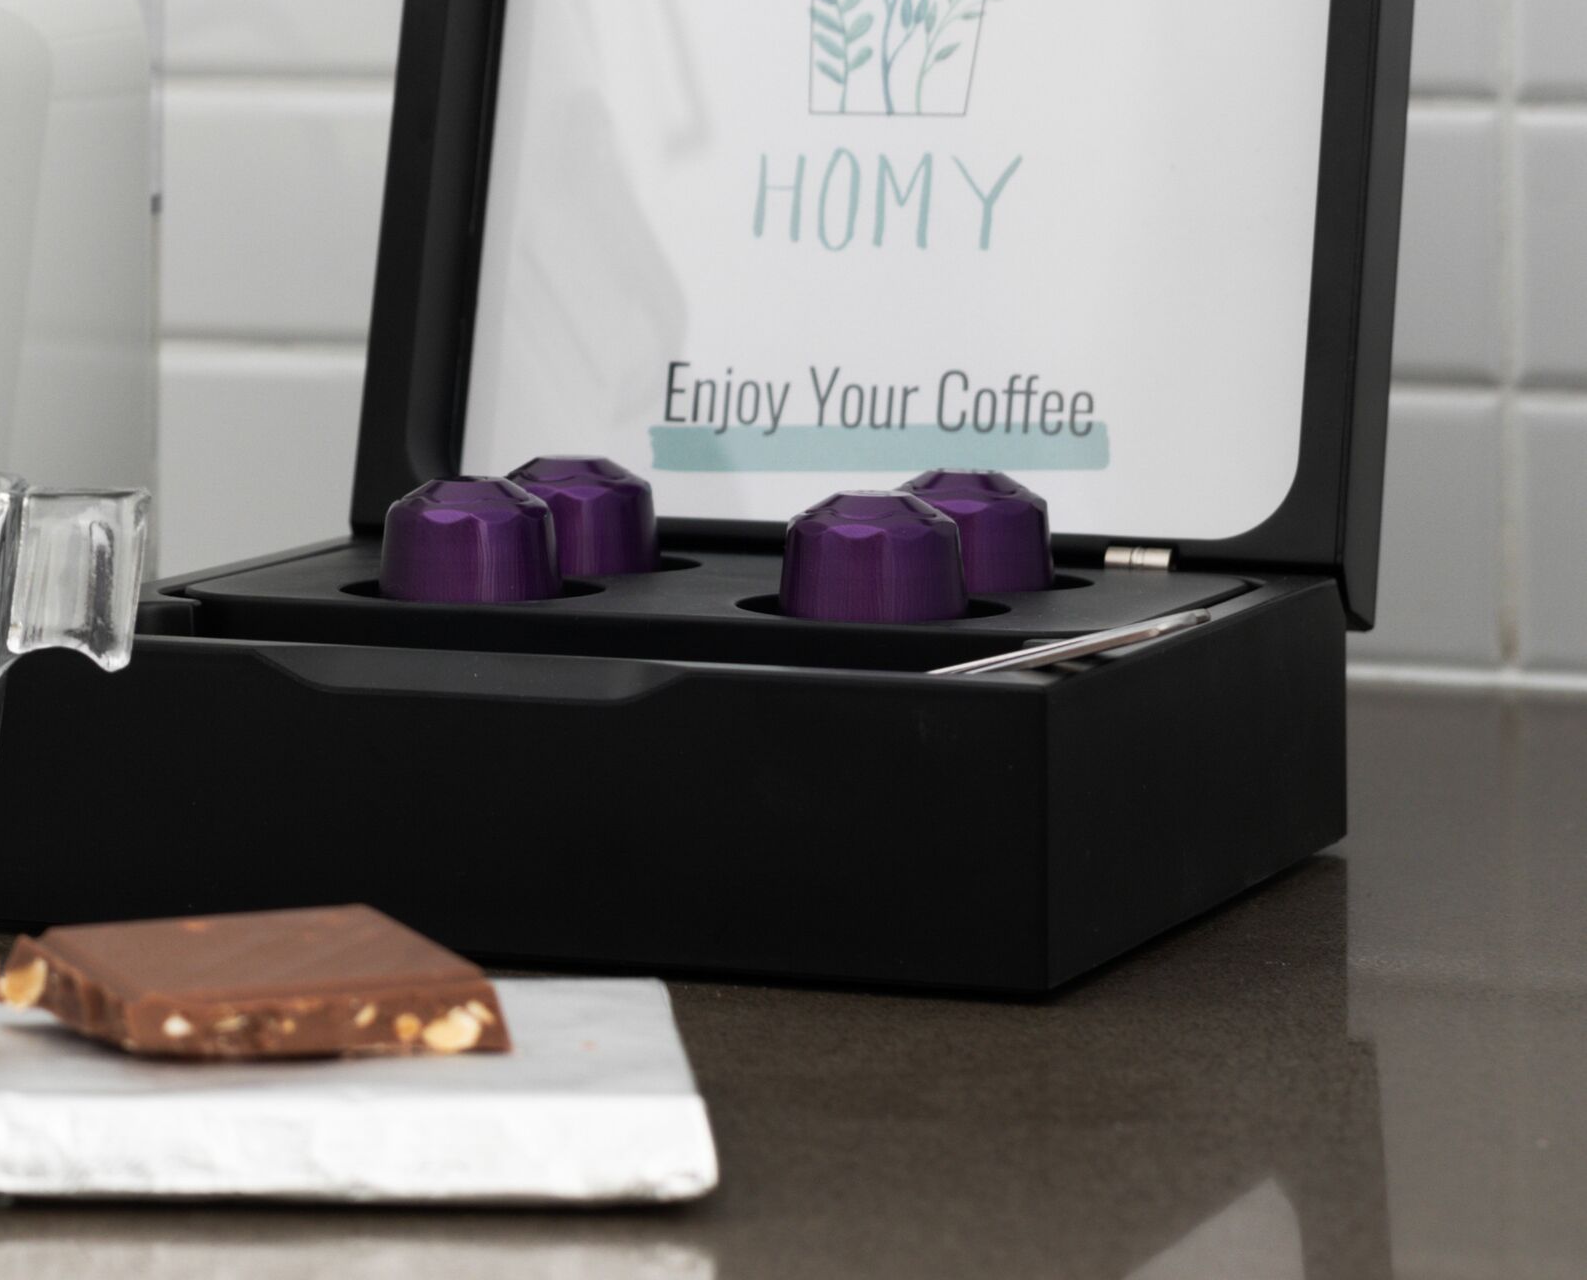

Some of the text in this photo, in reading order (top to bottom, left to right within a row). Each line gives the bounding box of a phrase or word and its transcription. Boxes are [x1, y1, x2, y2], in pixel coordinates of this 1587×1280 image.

[753, 147, 1023, 251] HOMY
[663, 361, 1096, 437] Enjoy Your Coffee
